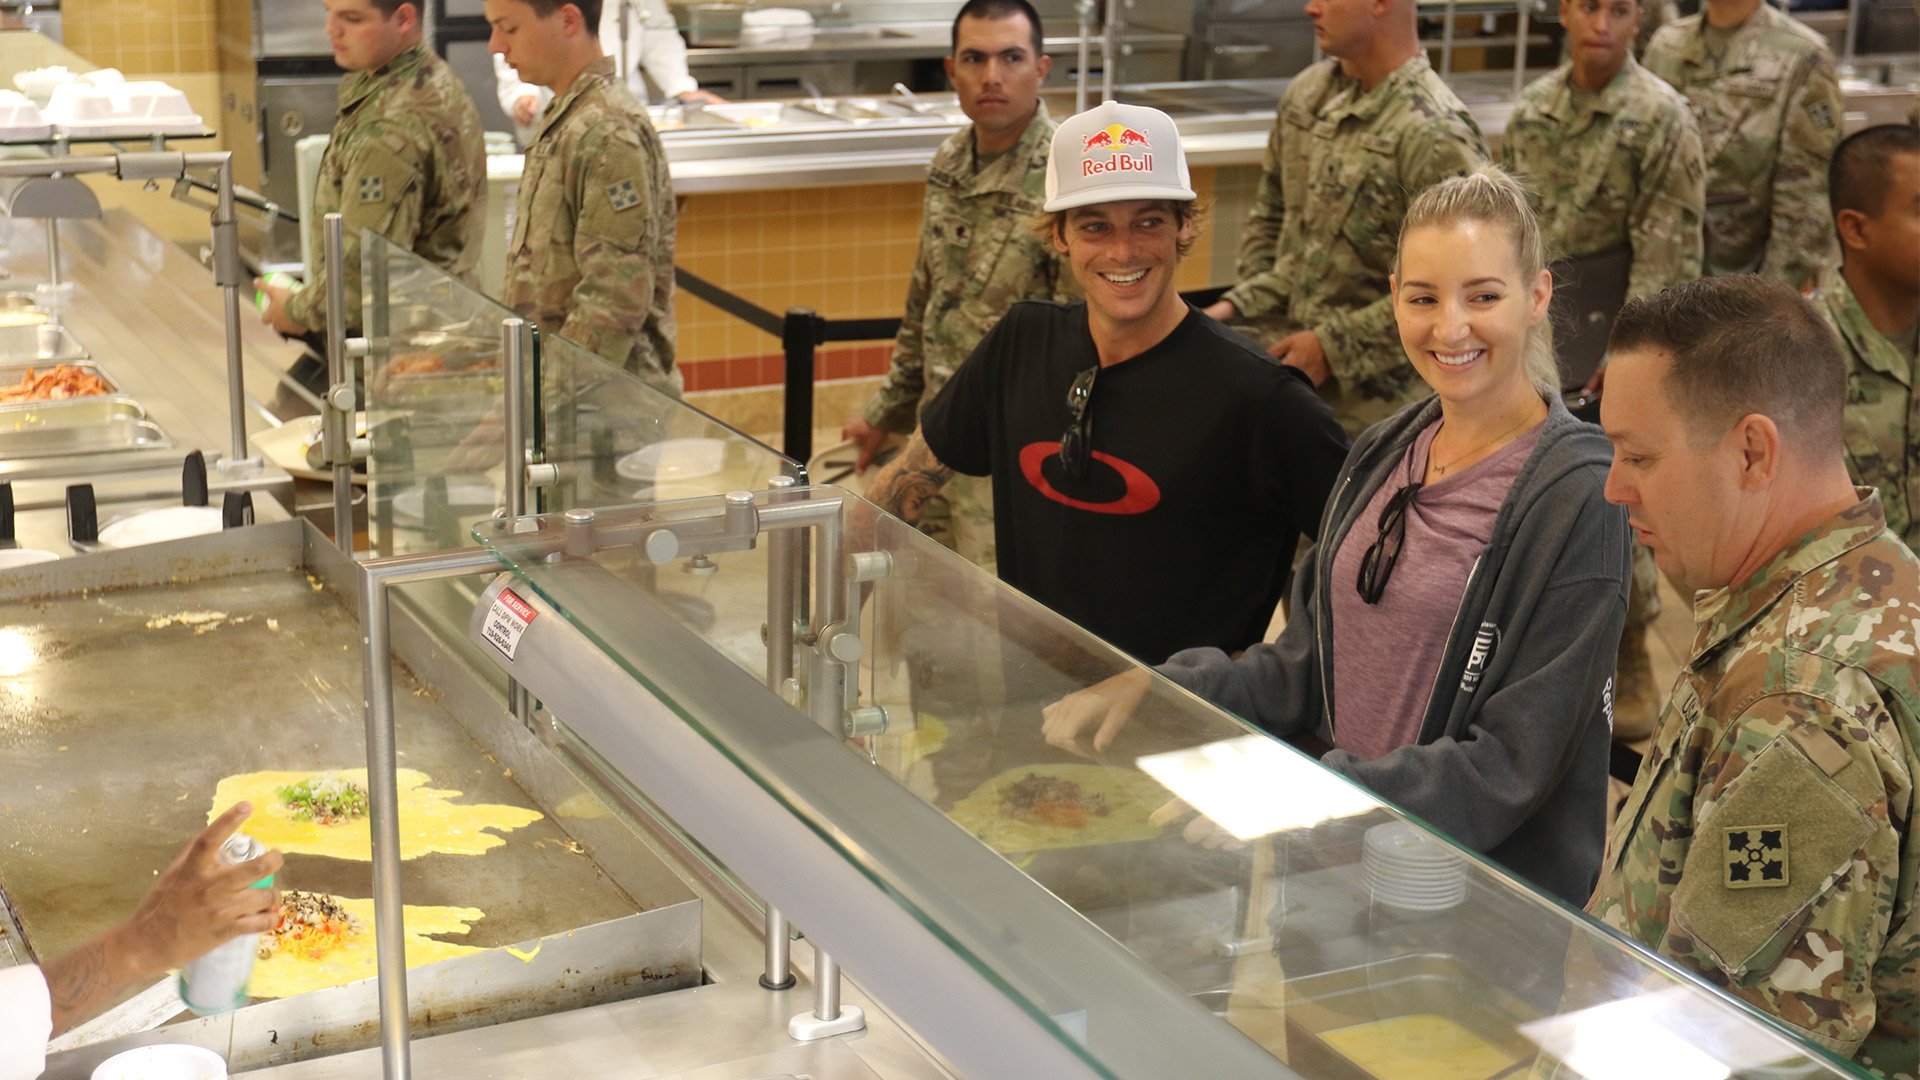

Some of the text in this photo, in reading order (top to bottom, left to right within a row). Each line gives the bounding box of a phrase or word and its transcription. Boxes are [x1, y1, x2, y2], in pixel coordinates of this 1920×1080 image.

[1082, 153, 1153, 177] Red Bull
[511, 601, 531, 618] SERVICE
[493, 620, 511, 639] CONTROL
